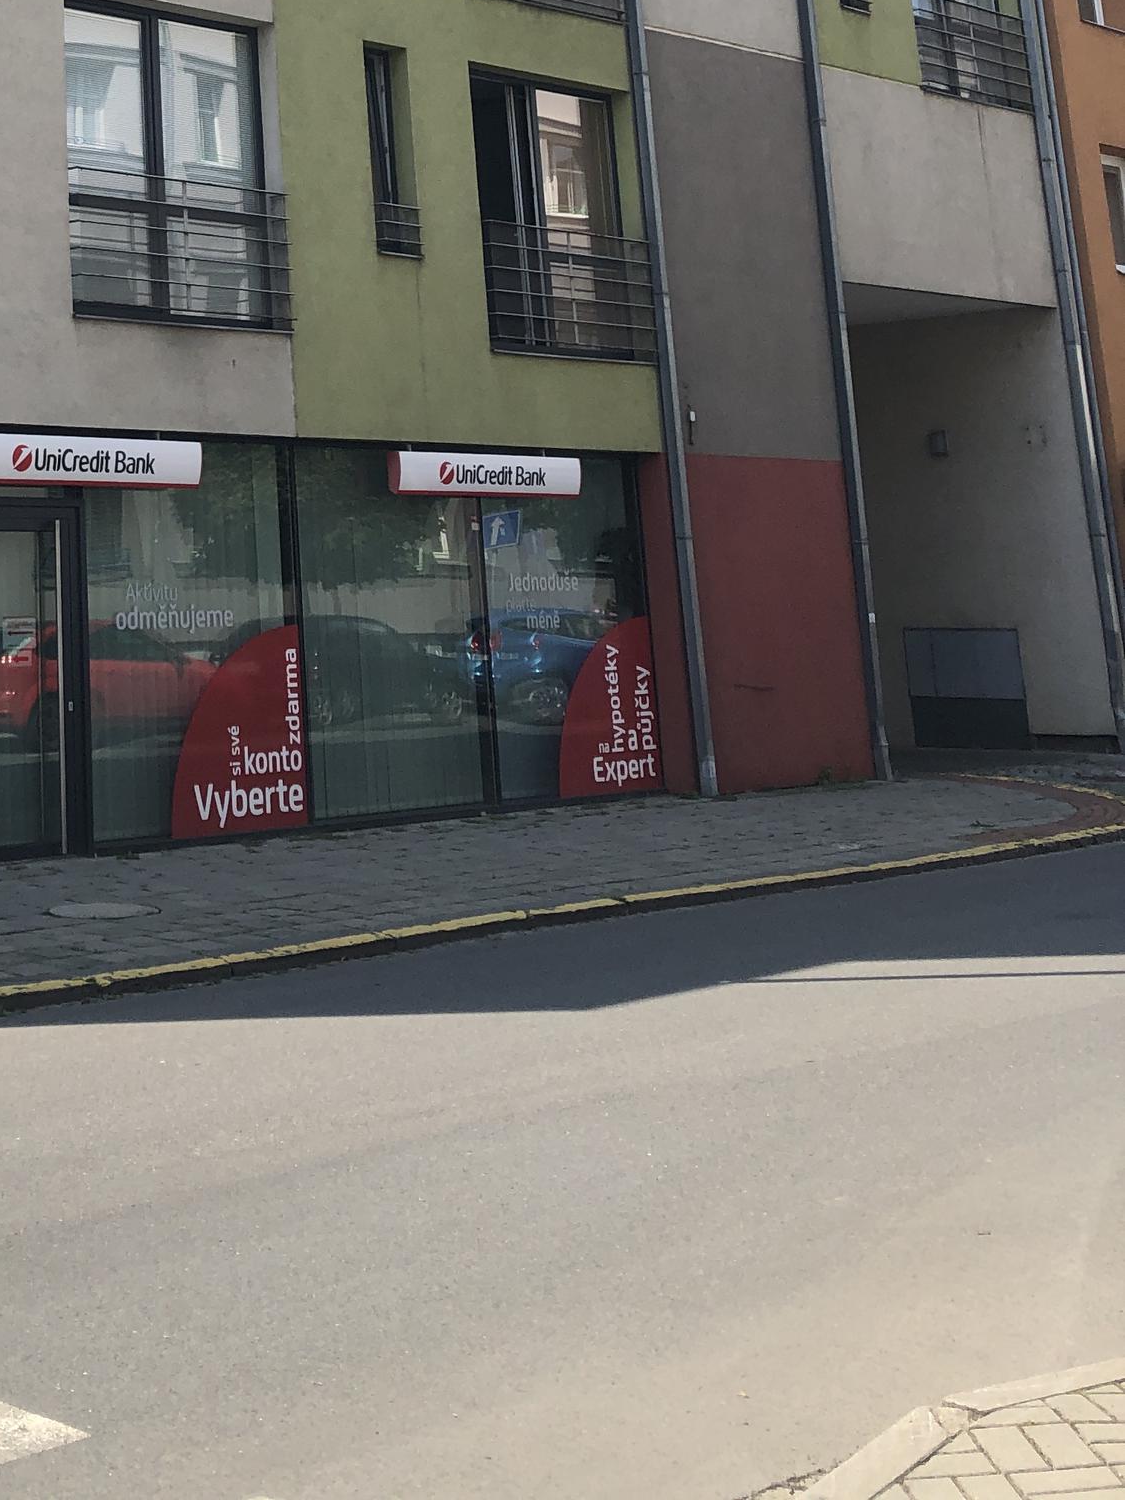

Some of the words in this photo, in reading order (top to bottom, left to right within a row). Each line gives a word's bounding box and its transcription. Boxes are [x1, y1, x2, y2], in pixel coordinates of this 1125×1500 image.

[34, 447, 110, 474] UniCredit
[114, 450, 156, 475] Bank
[456, 463, 512, 486] UniCredit
[515, 466, 546, 487] Bank
[509, 570, 579, 592] Jednoduše
[116, 604, 234, 634] odměňujeme
[527, 610, 560, 629] méně
[285, 648, 301, 745] zdarma
[605, 644, 626, 753] hypotéky
[635, 665, 657, 751] půjčky
[227, 725, 241, 755] své
[599, 742, 610, 754] na
[628, 729, 638, 751] a
[230, 762, 242, 776] si
[243, 746, 302, 775] konto
[593, 753, 656, 787] Expert
[194, 779, 304, 829] Vyberte
